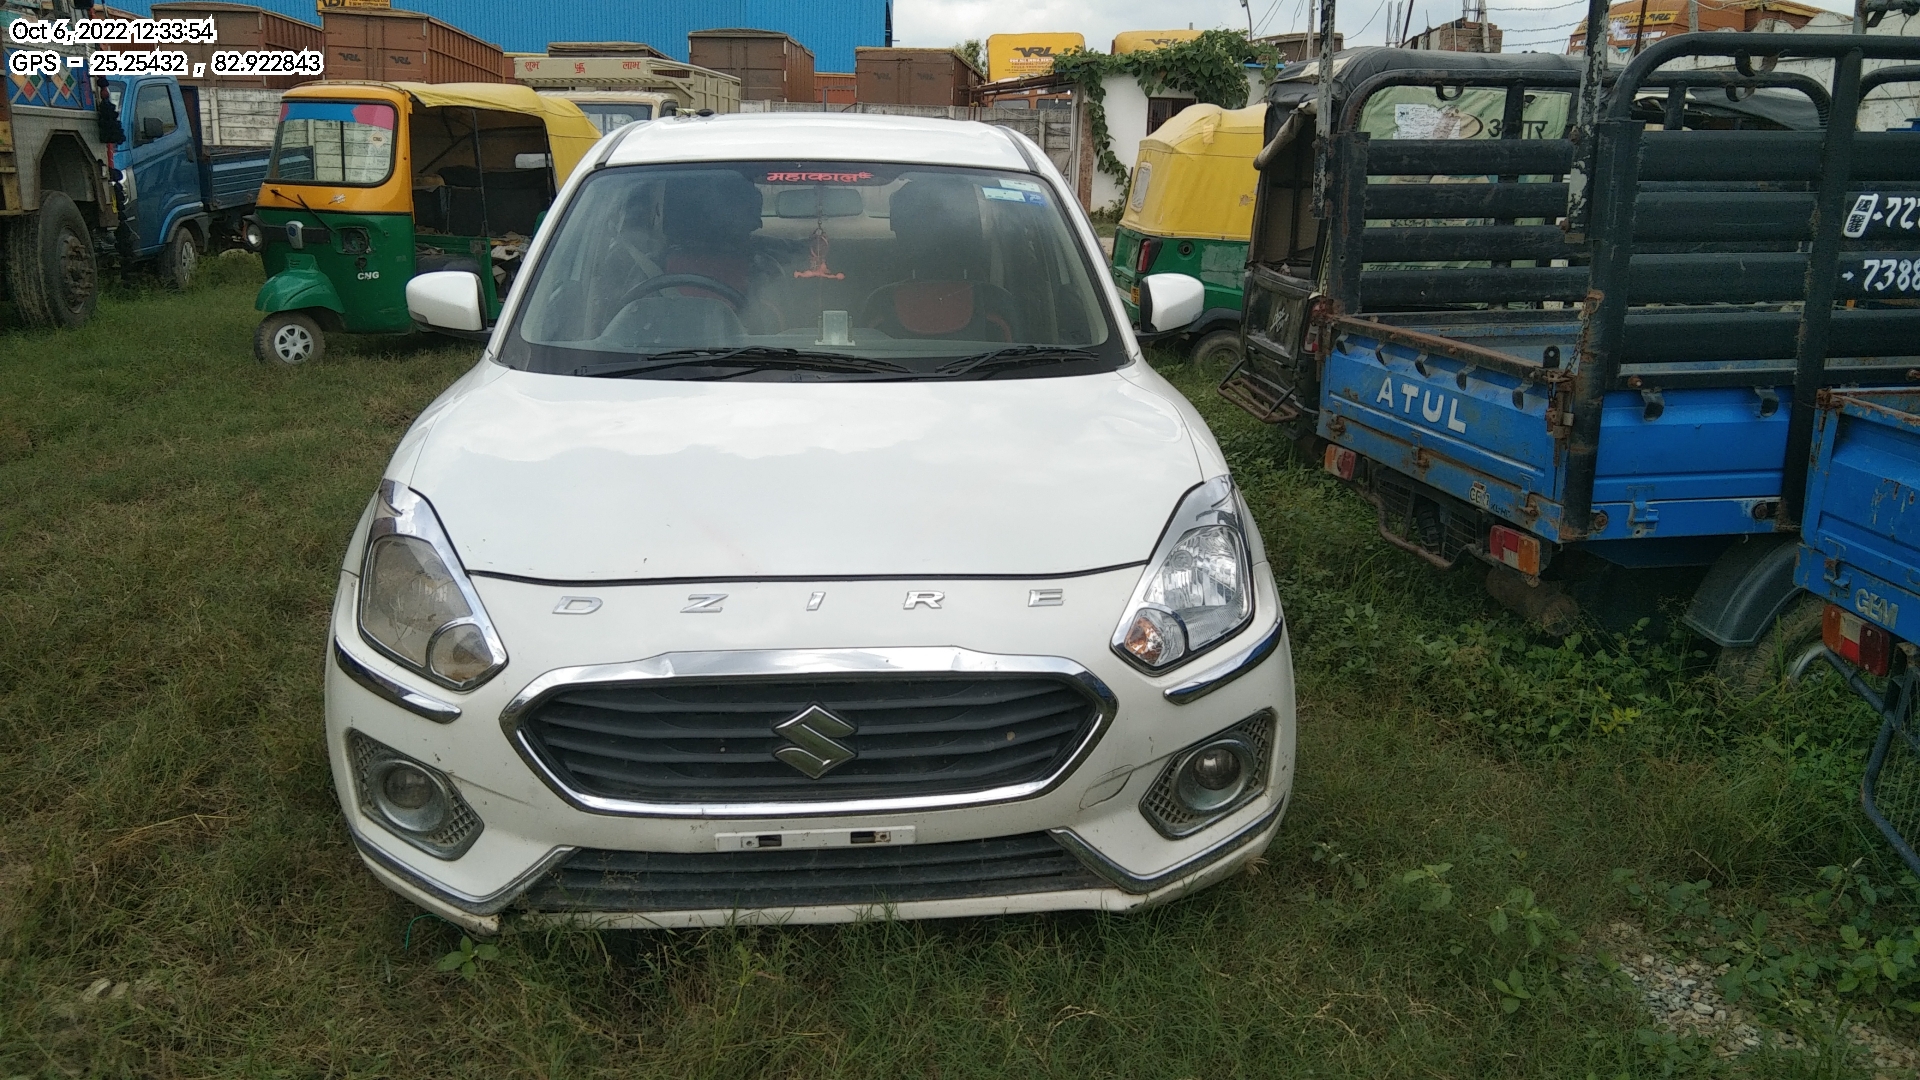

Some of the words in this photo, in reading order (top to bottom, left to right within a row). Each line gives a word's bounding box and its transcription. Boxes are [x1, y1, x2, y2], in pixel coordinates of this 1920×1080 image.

[1013, 46, 1056, 58] VRL
[524, 61, 540, 72] शुभ
[622, 61, 641, 70] लाभ
[766, 171, 861, 184] महाकाल
[1885, 196, 1920, 231] 72
[357, 271, 380, 281] CNG
[1376, 376, 1467, 435] ATUL
[551, 588, 1065, 615] DZIRE
[1855, 588, 1899, 631] GEM
